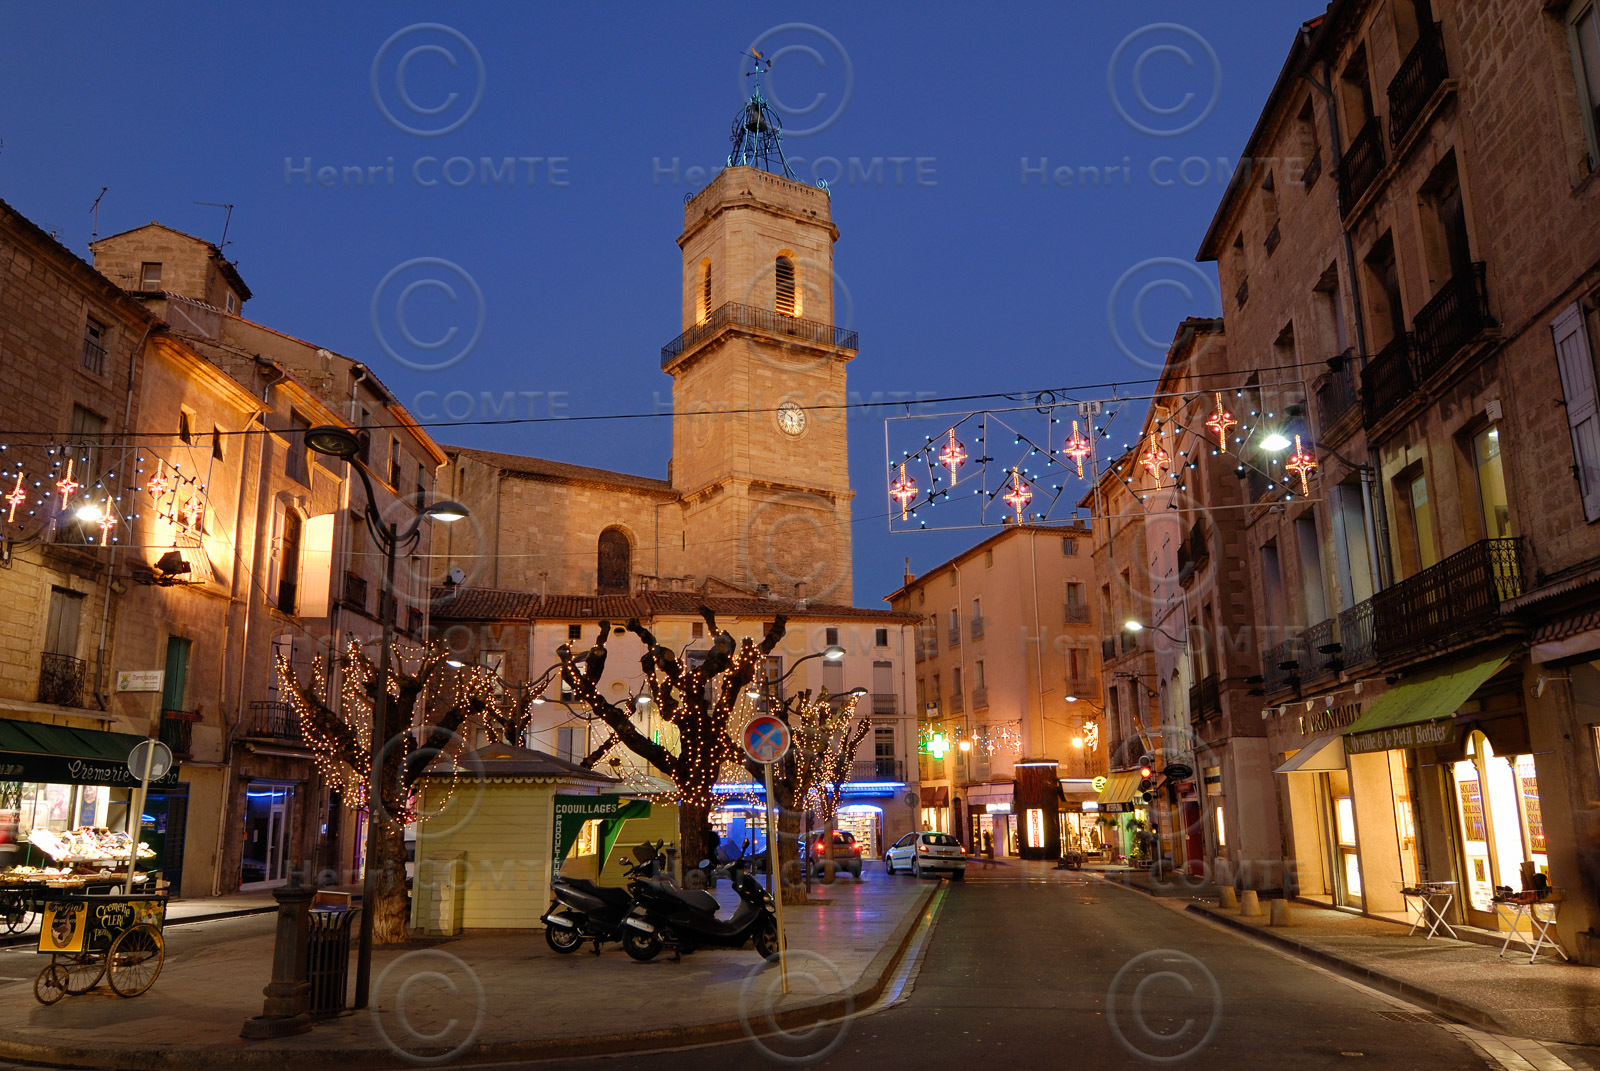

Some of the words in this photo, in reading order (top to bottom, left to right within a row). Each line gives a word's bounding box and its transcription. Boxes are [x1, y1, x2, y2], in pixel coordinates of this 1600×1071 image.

[1393, 727, 1412, 747] Petit
[1415, 723, 1446, 744] Bottier
[1460, 784, 1478, 793] SOLDES
[555, 804, 617, 814] COQUILLAGES
[553, 814, 562, 876] PRODUCTEUR
